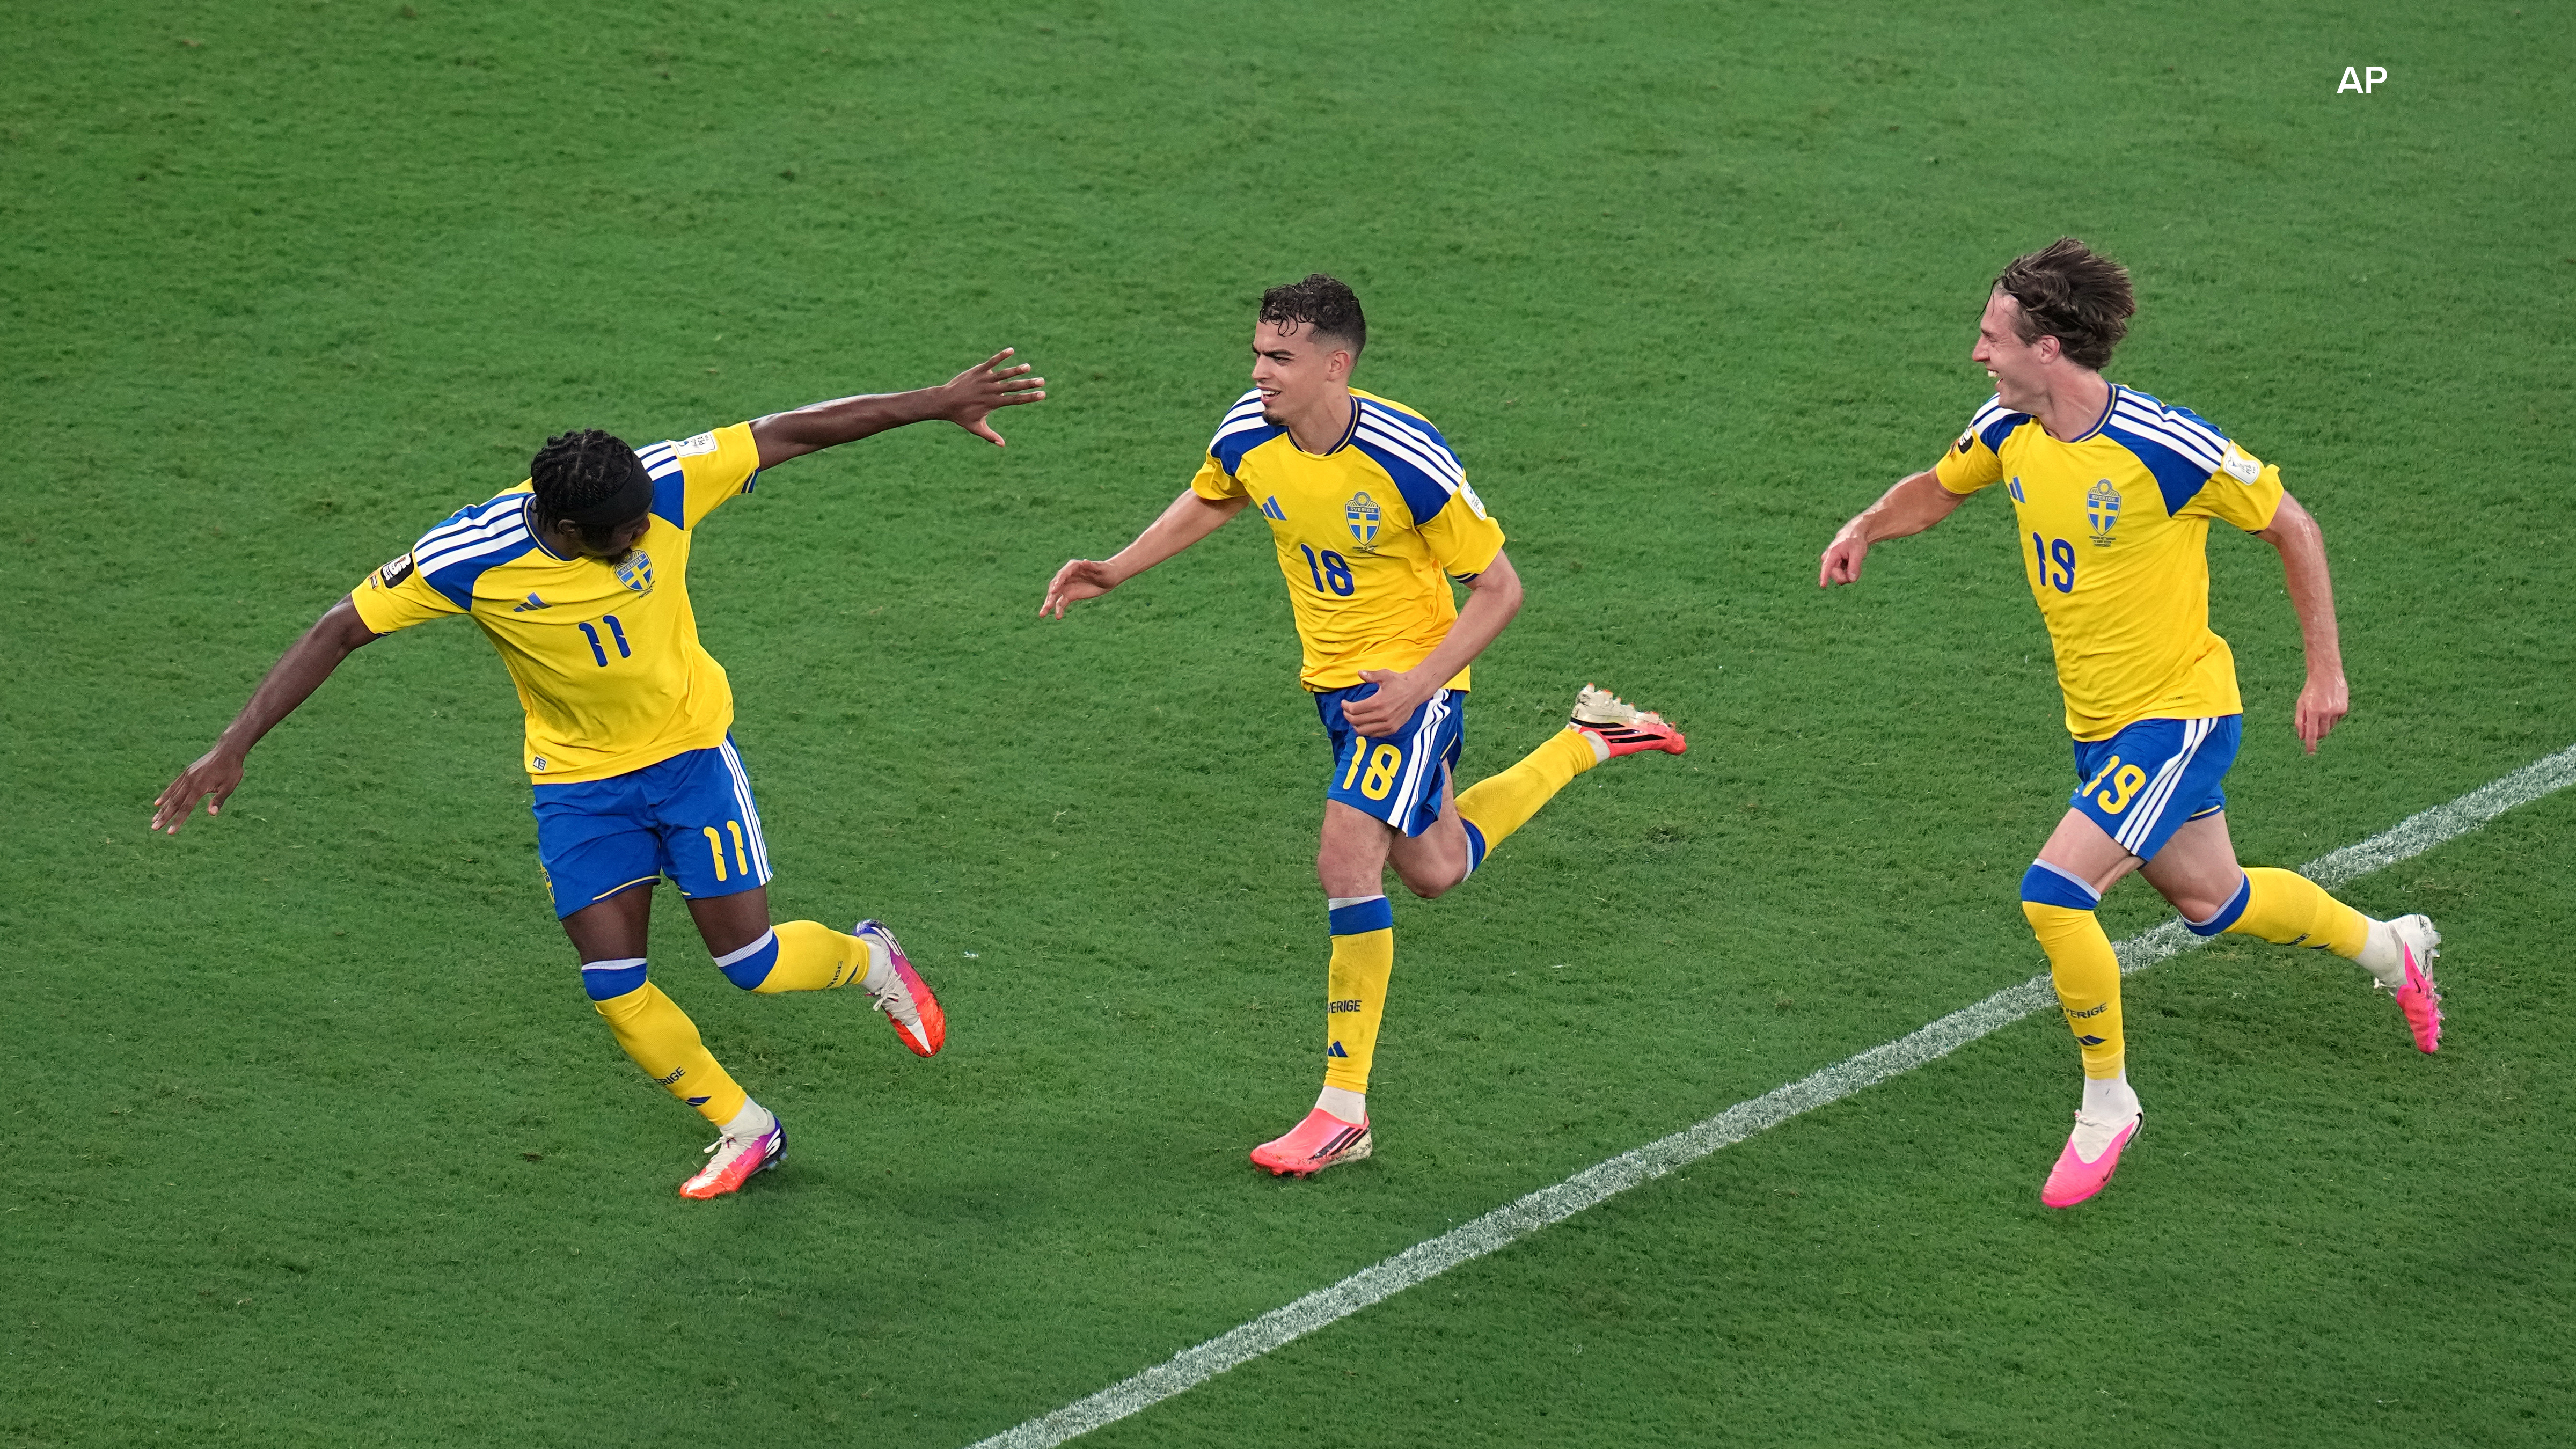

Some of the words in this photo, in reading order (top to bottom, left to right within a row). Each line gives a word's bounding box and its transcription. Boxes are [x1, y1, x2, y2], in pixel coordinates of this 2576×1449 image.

[620, 555, 643, 573] SVERIGE
[1301, 544, 1355, 596] 18
[2033, 532, 2075, 593] 19
[579, 615, 631, 667] 11
[1343, 736, 1402, 801] 18
[2082, 755, 2146, 815] 19
[704, 820, 748, 881] 11
